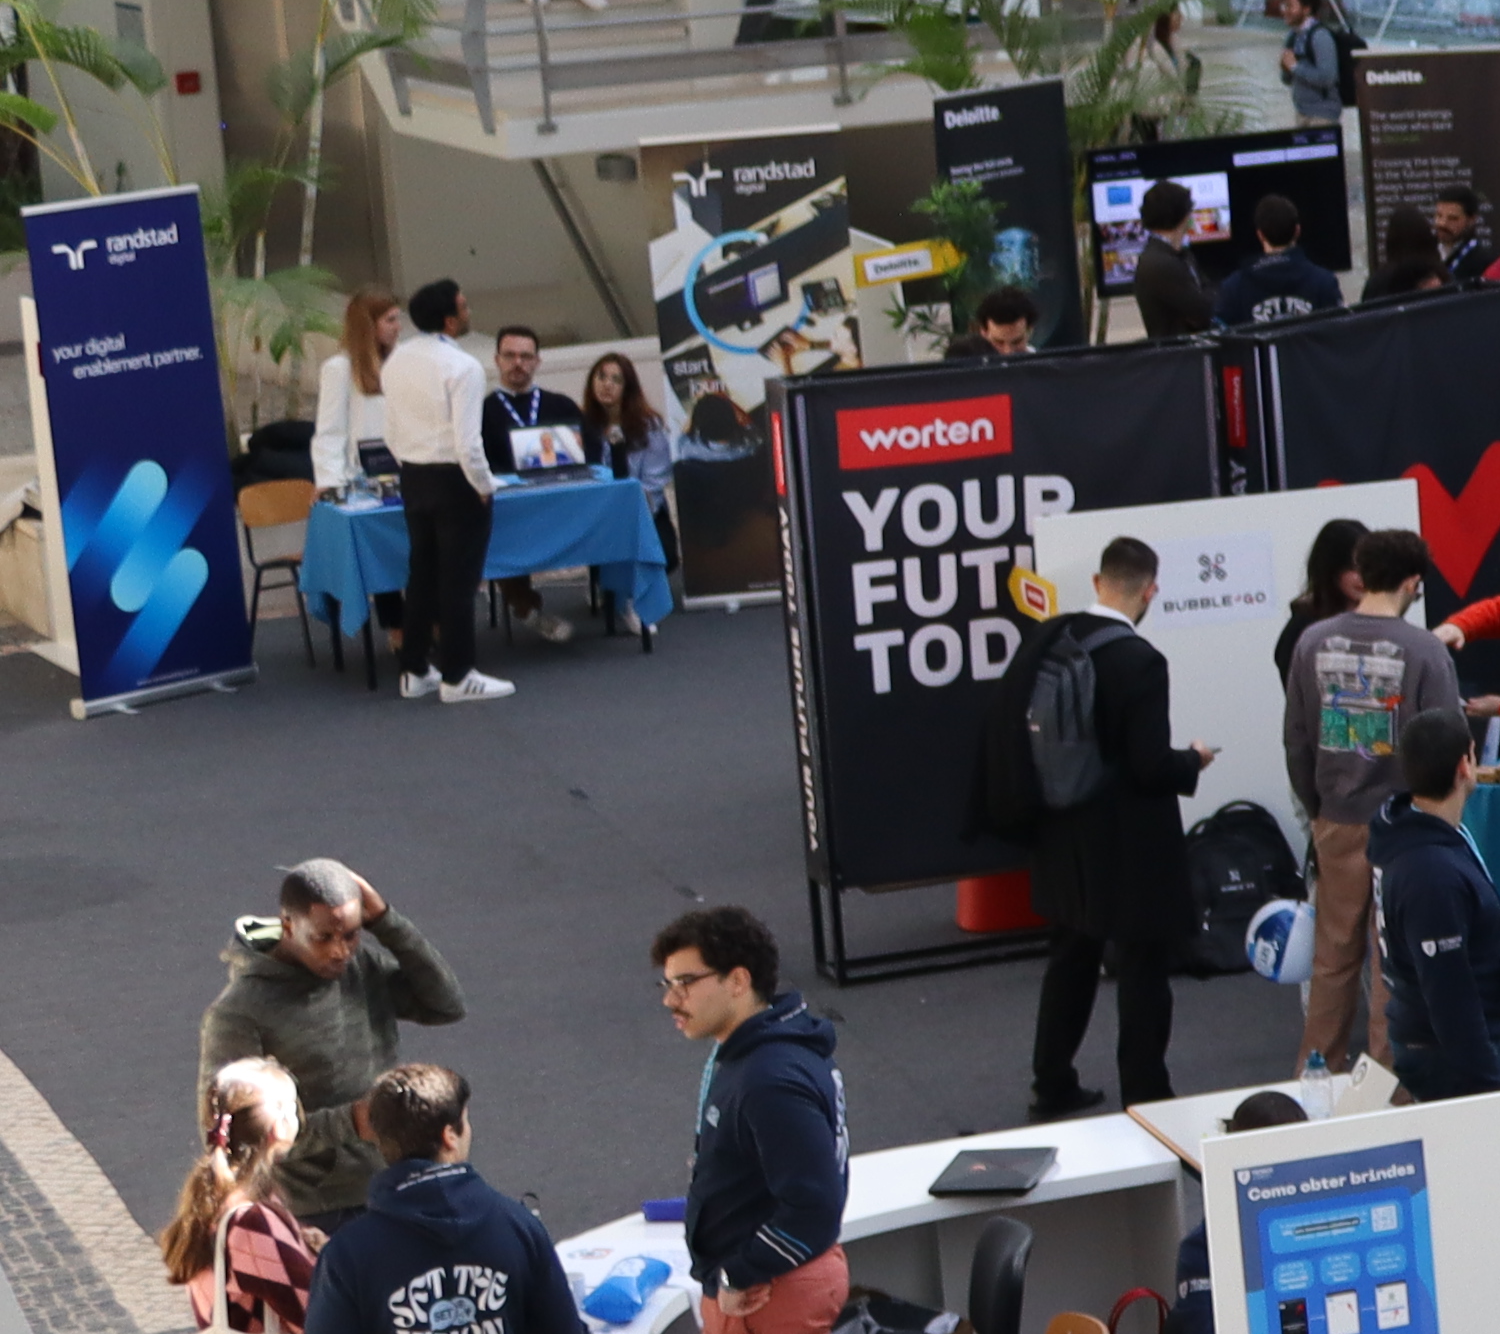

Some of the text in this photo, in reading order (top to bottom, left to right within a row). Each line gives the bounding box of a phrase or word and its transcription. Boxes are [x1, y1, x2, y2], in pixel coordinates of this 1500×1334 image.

[733, 158, 816, 182] randstad
[105, 222, 179, 253] randstad
[52, 332, 126, 364] your digital
[72, 352, 152, 379] enablement
[859, 418, 994, 451] worten
[851, 545, 1033, 625] FUT
[1248, 1162, 1415, 1201] Como obter brindes
[388, 1264, 509, 1328] SET THE
